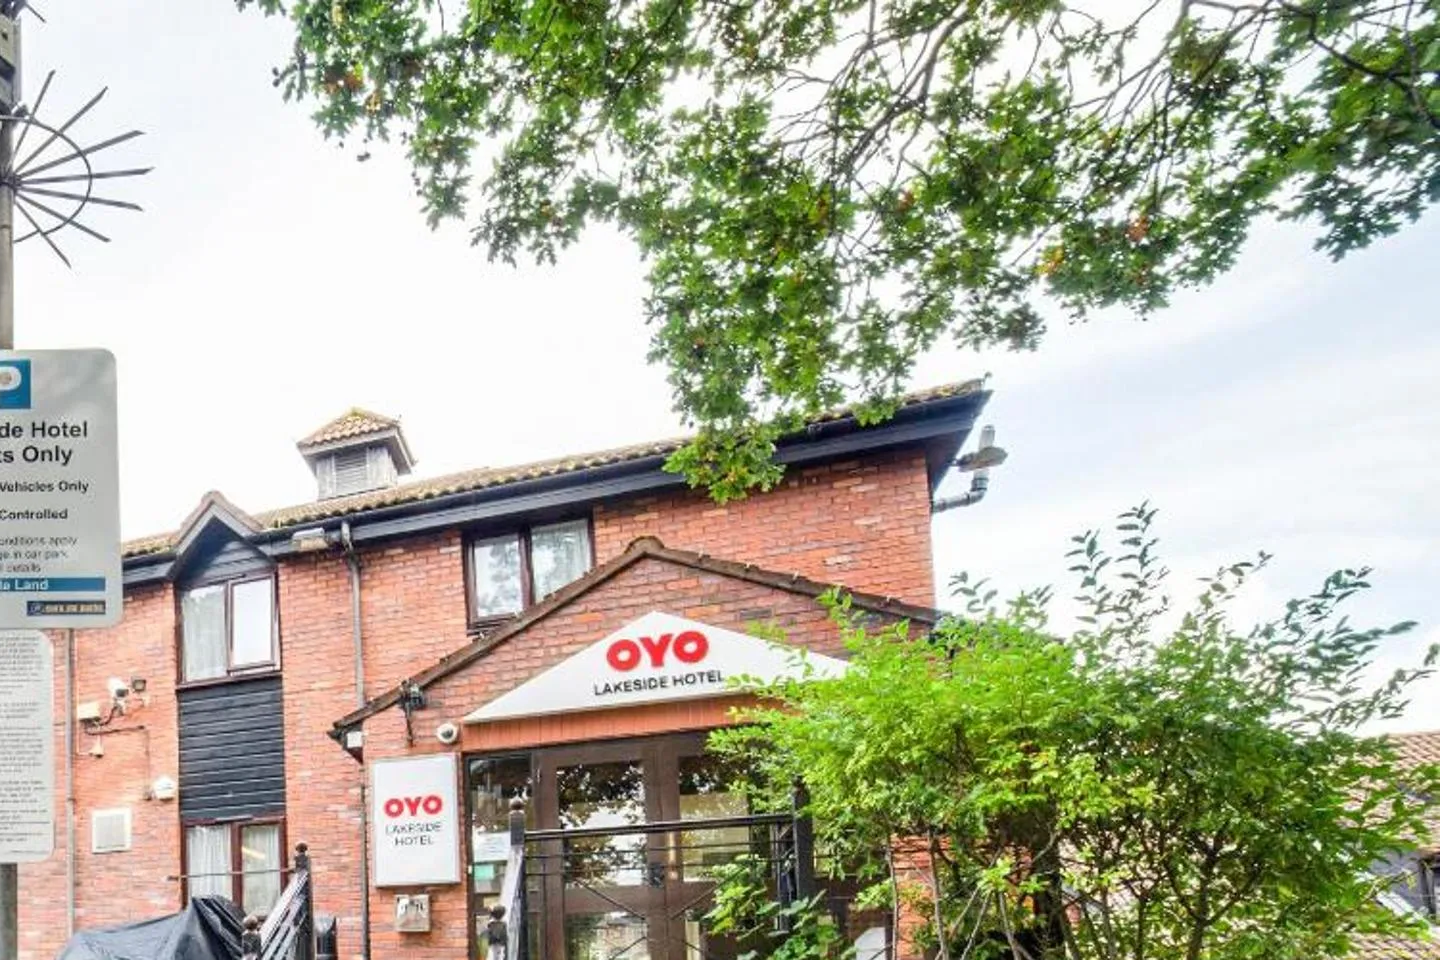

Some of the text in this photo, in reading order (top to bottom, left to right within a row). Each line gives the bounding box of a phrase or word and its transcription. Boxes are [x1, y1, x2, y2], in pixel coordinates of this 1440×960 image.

[31, 421, 88, 438] Hotel
[22, 445, 73, 467] Only
[59, 480, 89, 494] Only
[15, 578, 49, 591] Land
[606, 630, 709, 672] OYO
[594, 670, 725, 697] LAKESIDE HOTEL
[384, 795, 443, 818] OYO
[385, 822, 443, 834] LAKESIDE
[394, 834, 435, 846] HOTEL
